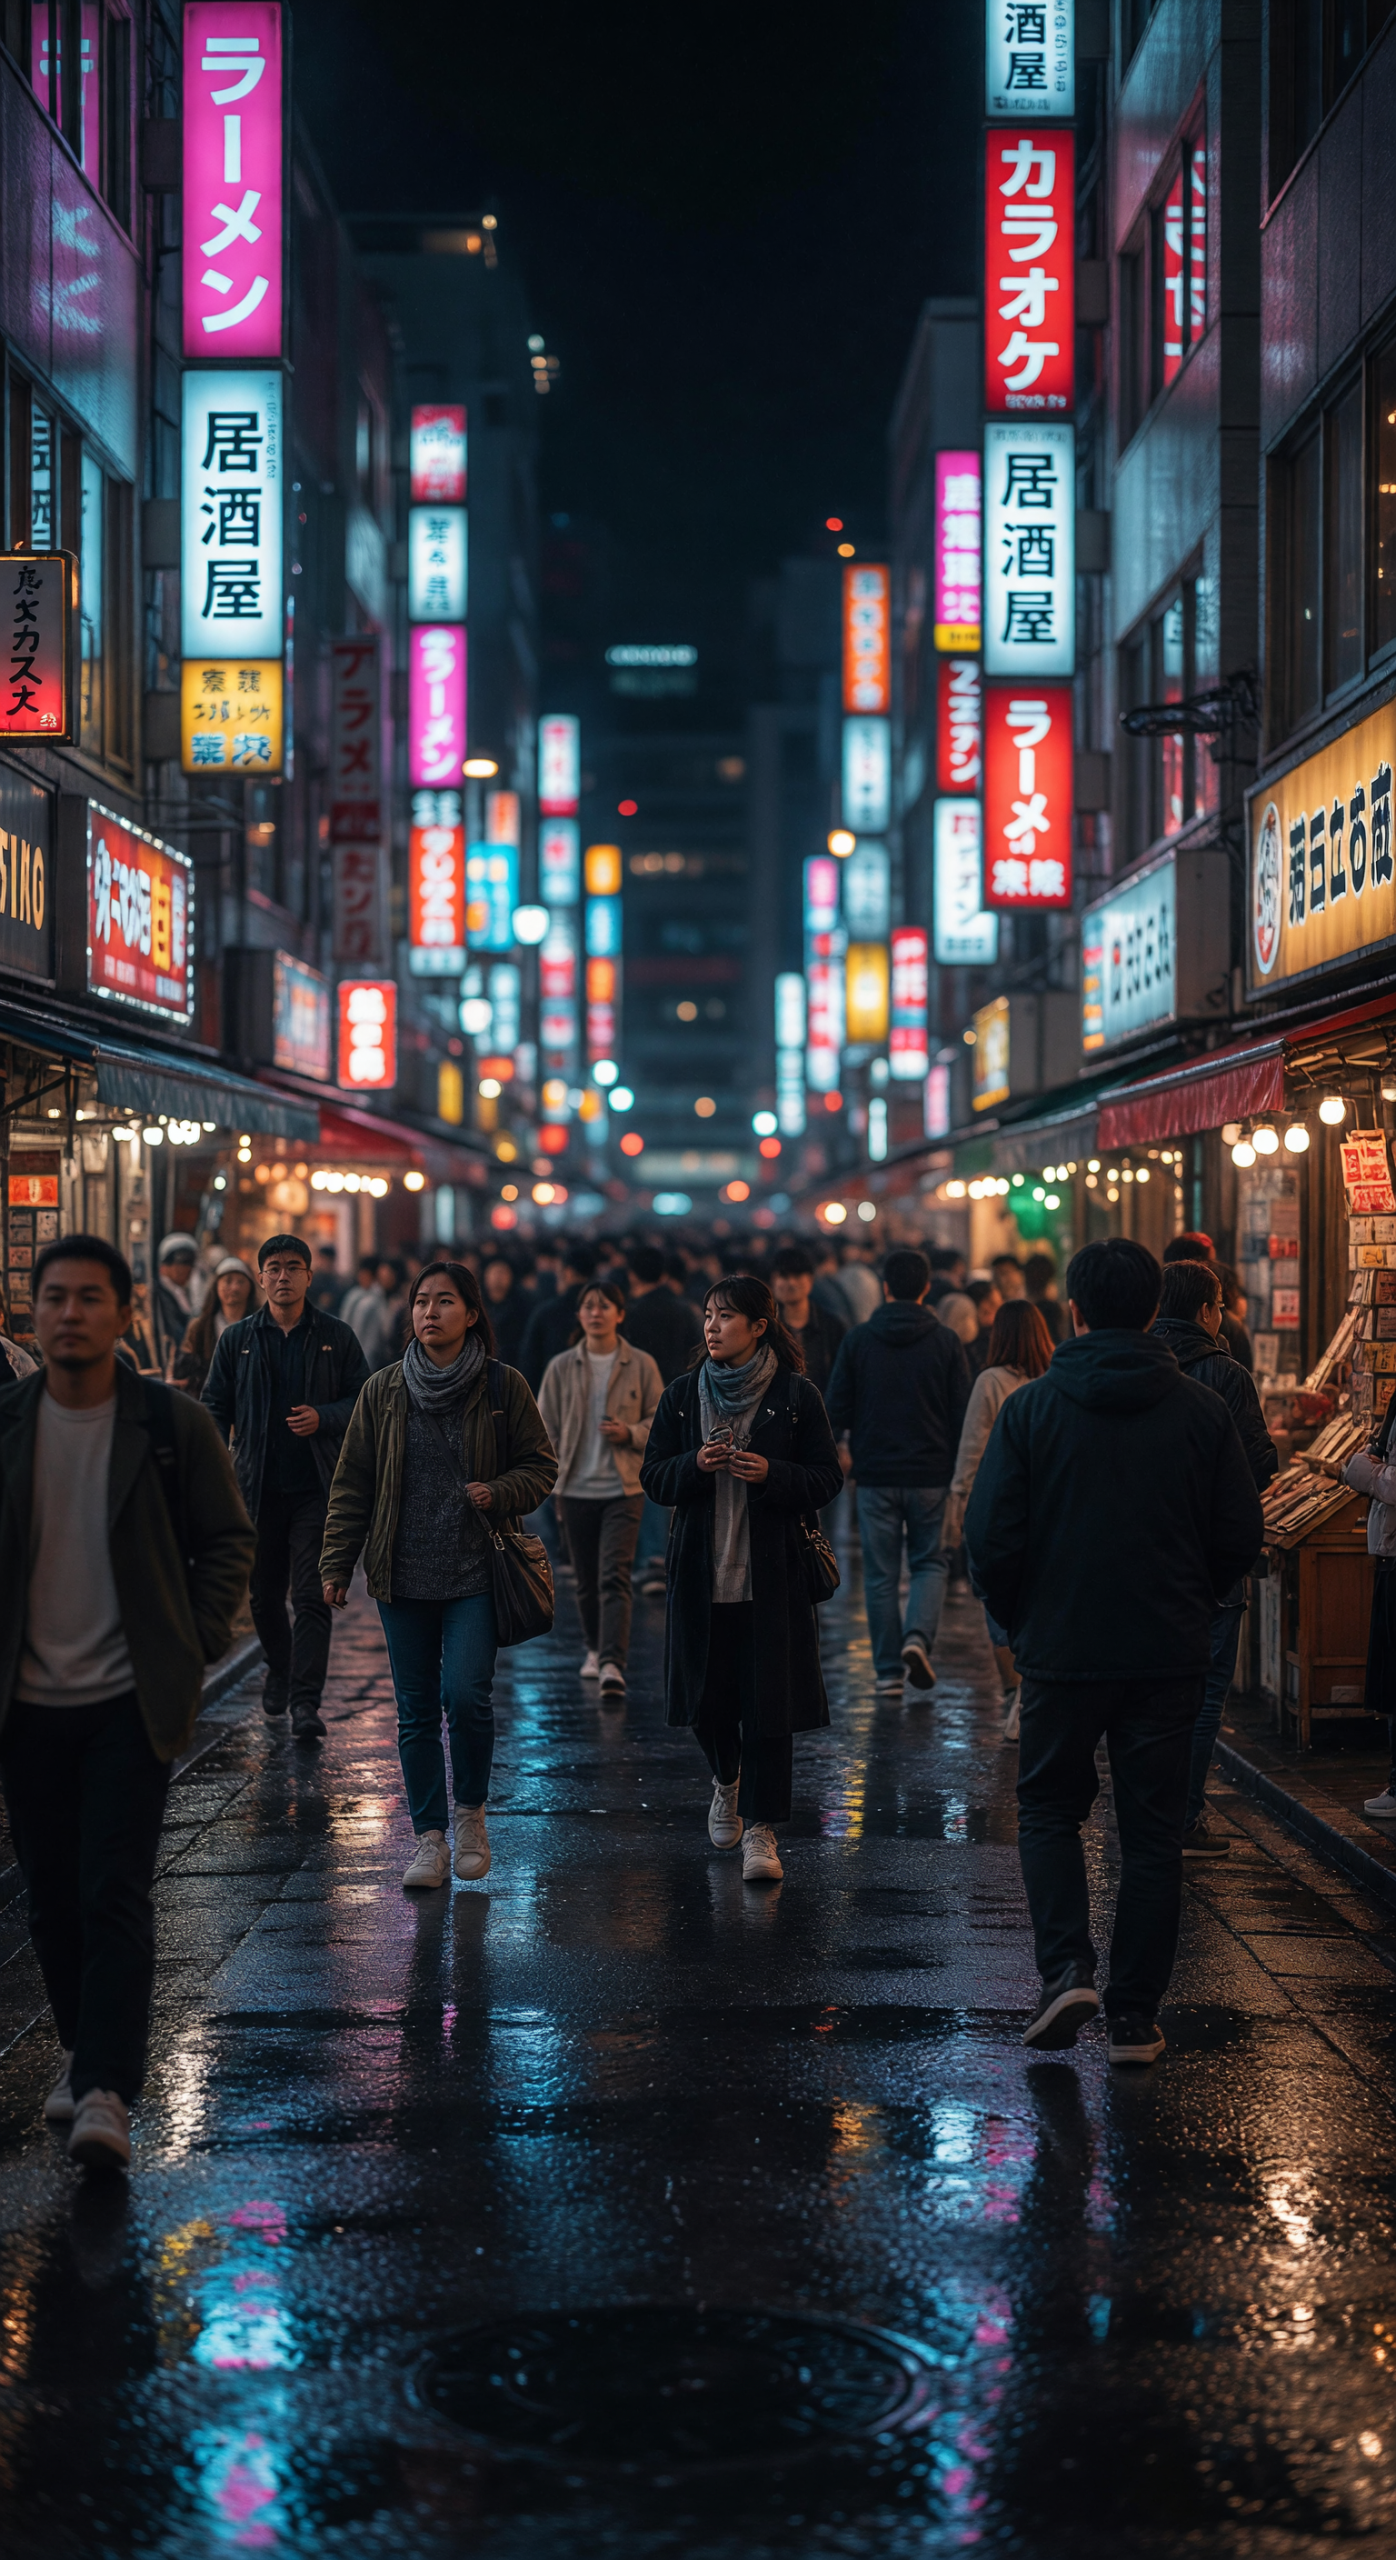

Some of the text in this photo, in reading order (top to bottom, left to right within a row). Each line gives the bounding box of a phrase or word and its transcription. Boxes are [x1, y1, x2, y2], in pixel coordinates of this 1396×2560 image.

[1003, 2, 1049, 91] 酒屋
[200, 37, 270, 334] ラーメン
[997, 139, 1060, 391] カラオケ
[200, 410, 264, 620] 居酒屋
[1002, 452, 1059, 645] 居酒屋
